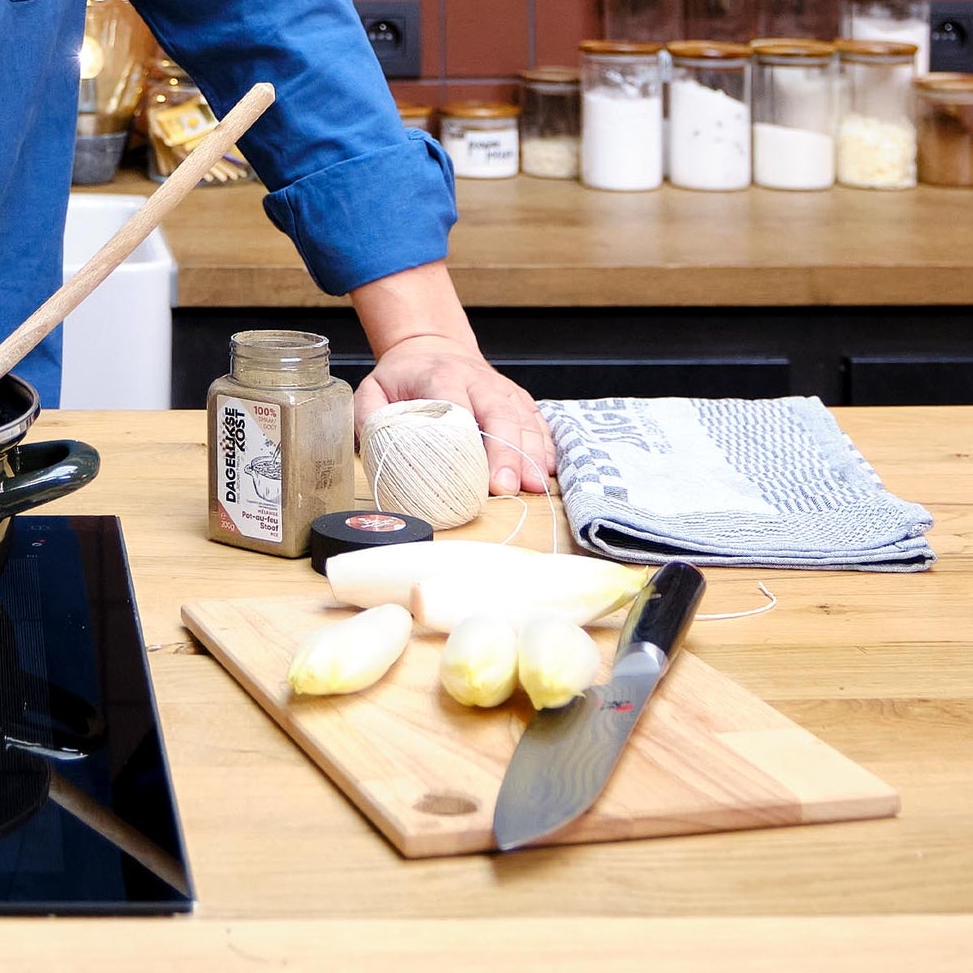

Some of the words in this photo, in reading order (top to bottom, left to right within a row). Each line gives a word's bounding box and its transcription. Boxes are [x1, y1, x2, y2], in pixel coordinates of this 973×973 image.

[254, 406, 277, 418] 100%
[235, 410, 246, 452] KOST
[225, 407, 237, 503] DAGELIJKSE
[242, 511, 279, 524] Pot-au-feu
[260, 522, 279, 532] Stoof
